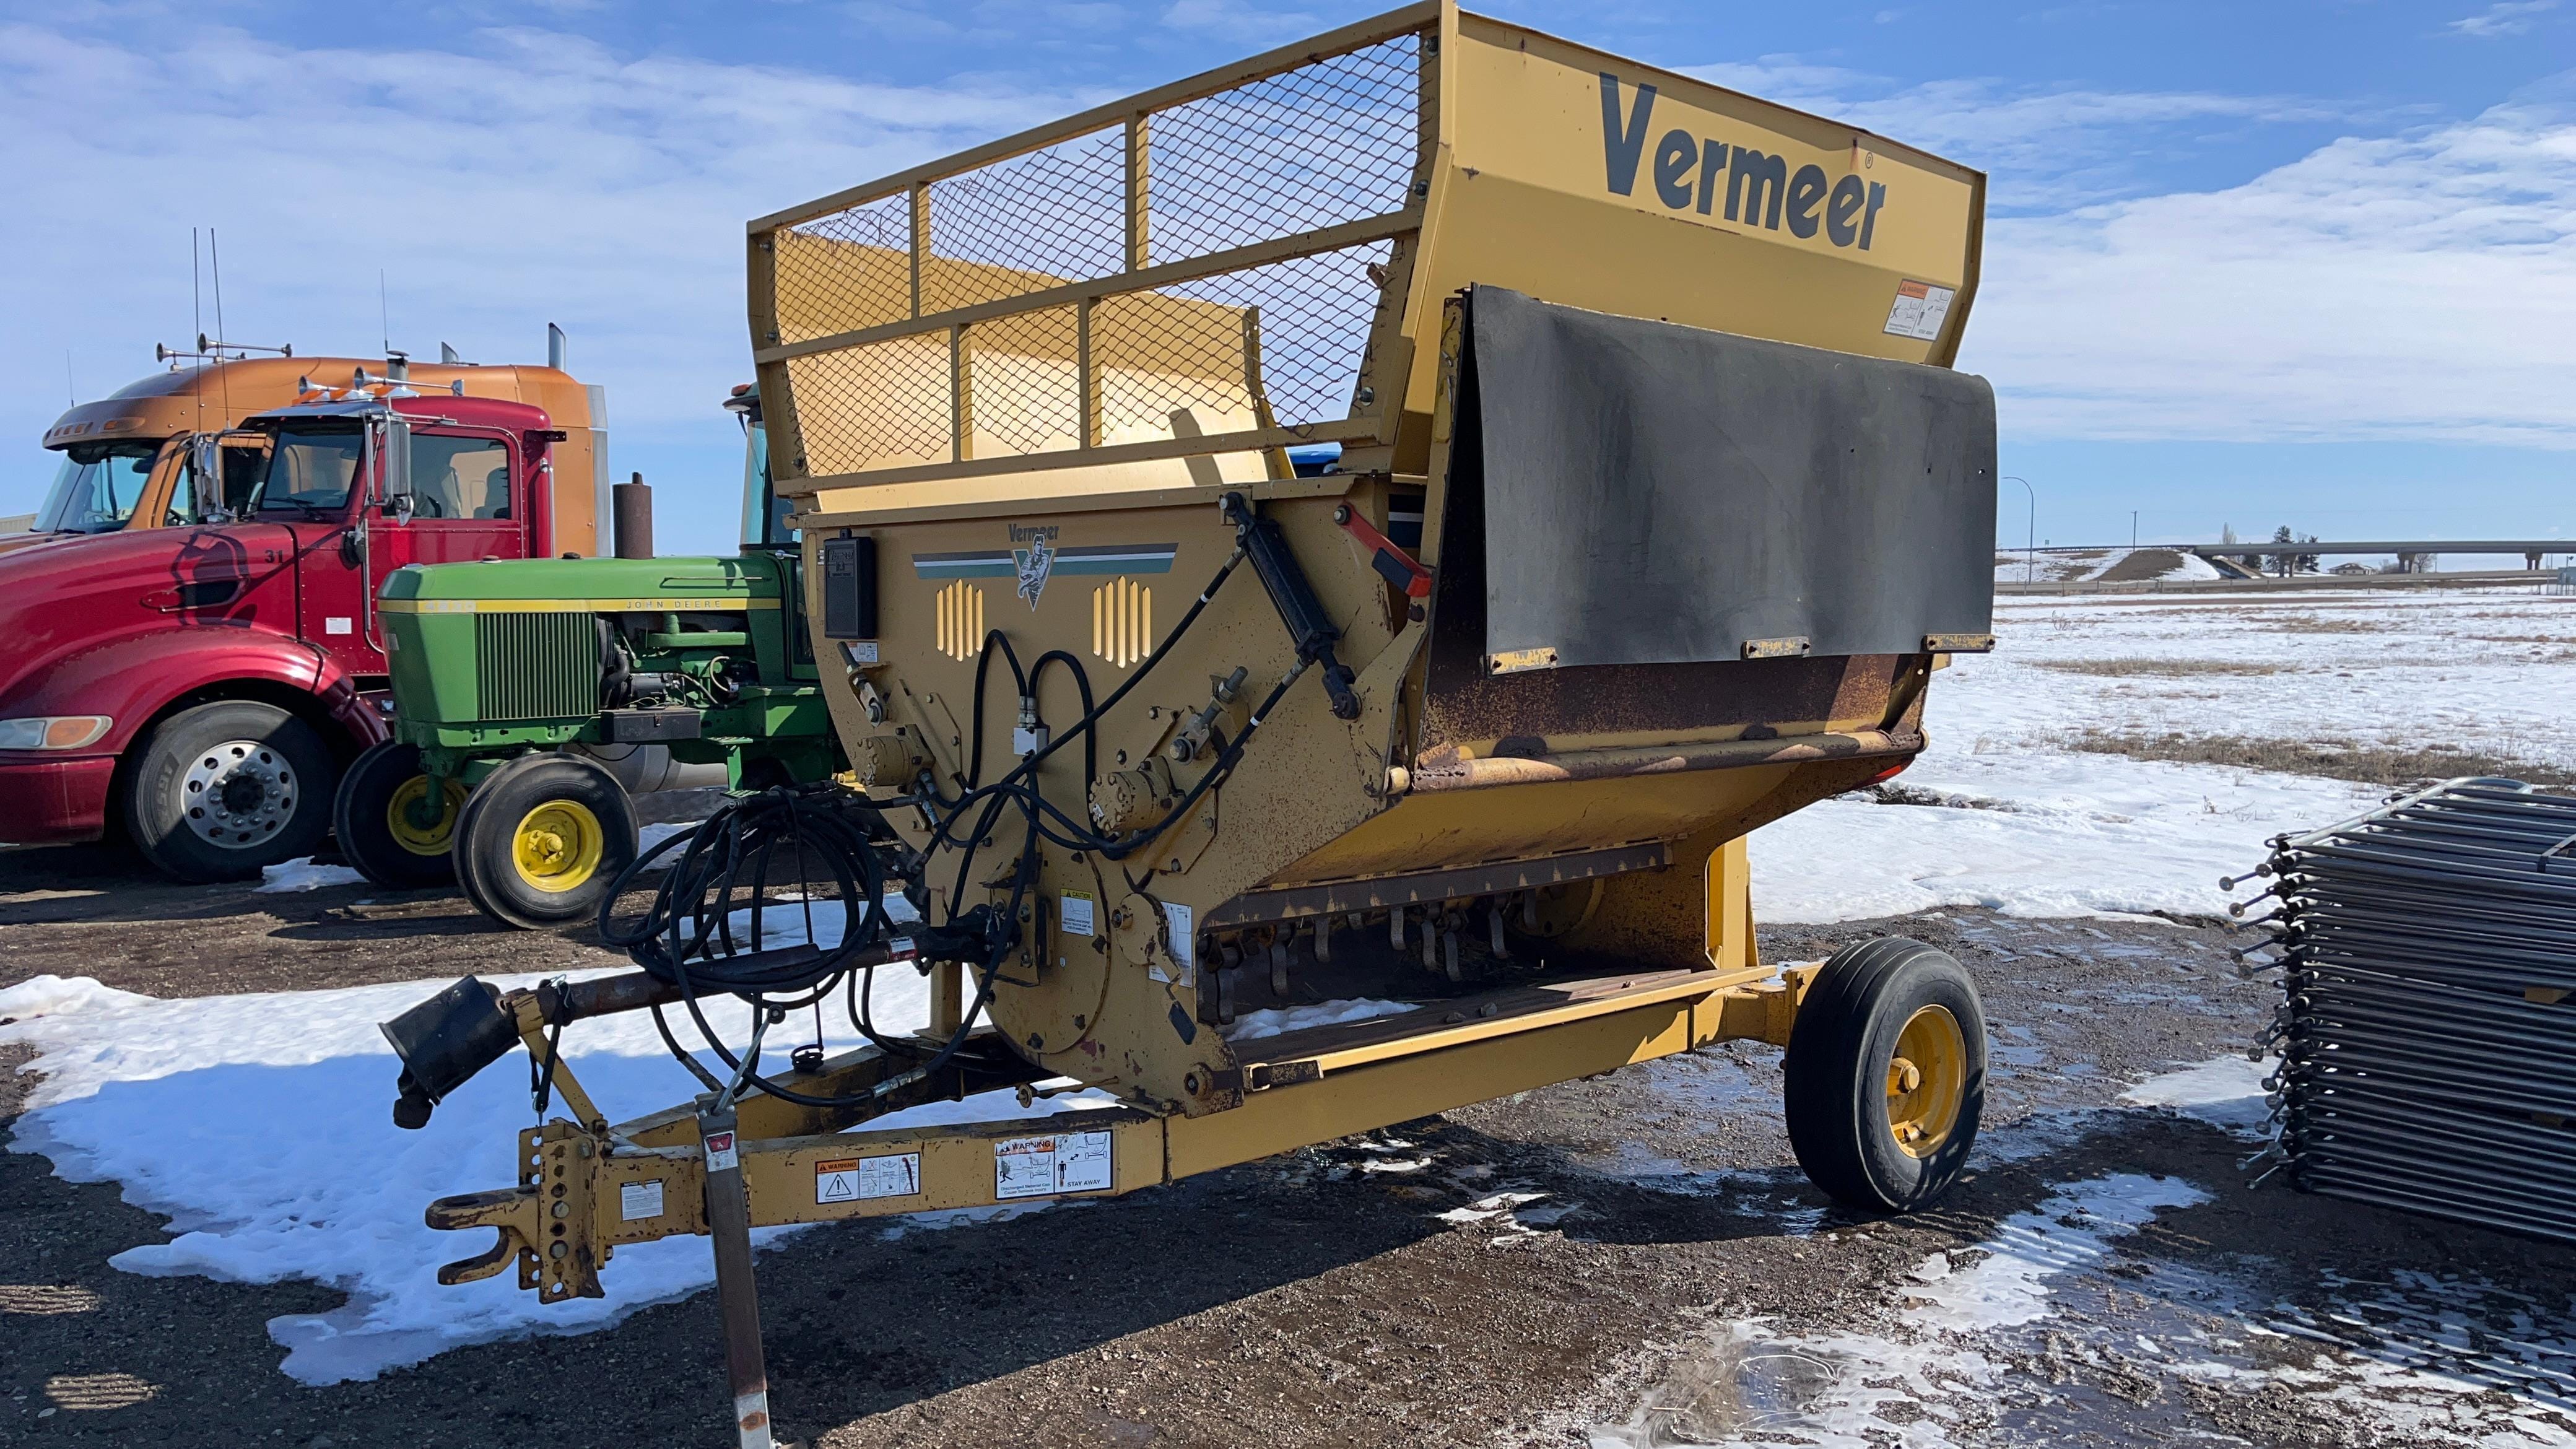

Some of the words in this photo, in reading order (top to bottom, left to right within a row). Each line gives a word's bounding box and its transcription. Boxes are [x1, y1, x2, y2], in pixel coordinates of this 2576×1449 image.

[1599, 72, 1886, 251] Vermeer
[1008, 523, 1059, 542] Vermeer
[265, 550, 282, 563] 31
[627, 601, 663, 609] JOHN
[674, 600, 721, 608] DEERE
[1012, 1140, 1051, 1150] WARNING
[827, 1162, 856, 1170] WARNING
